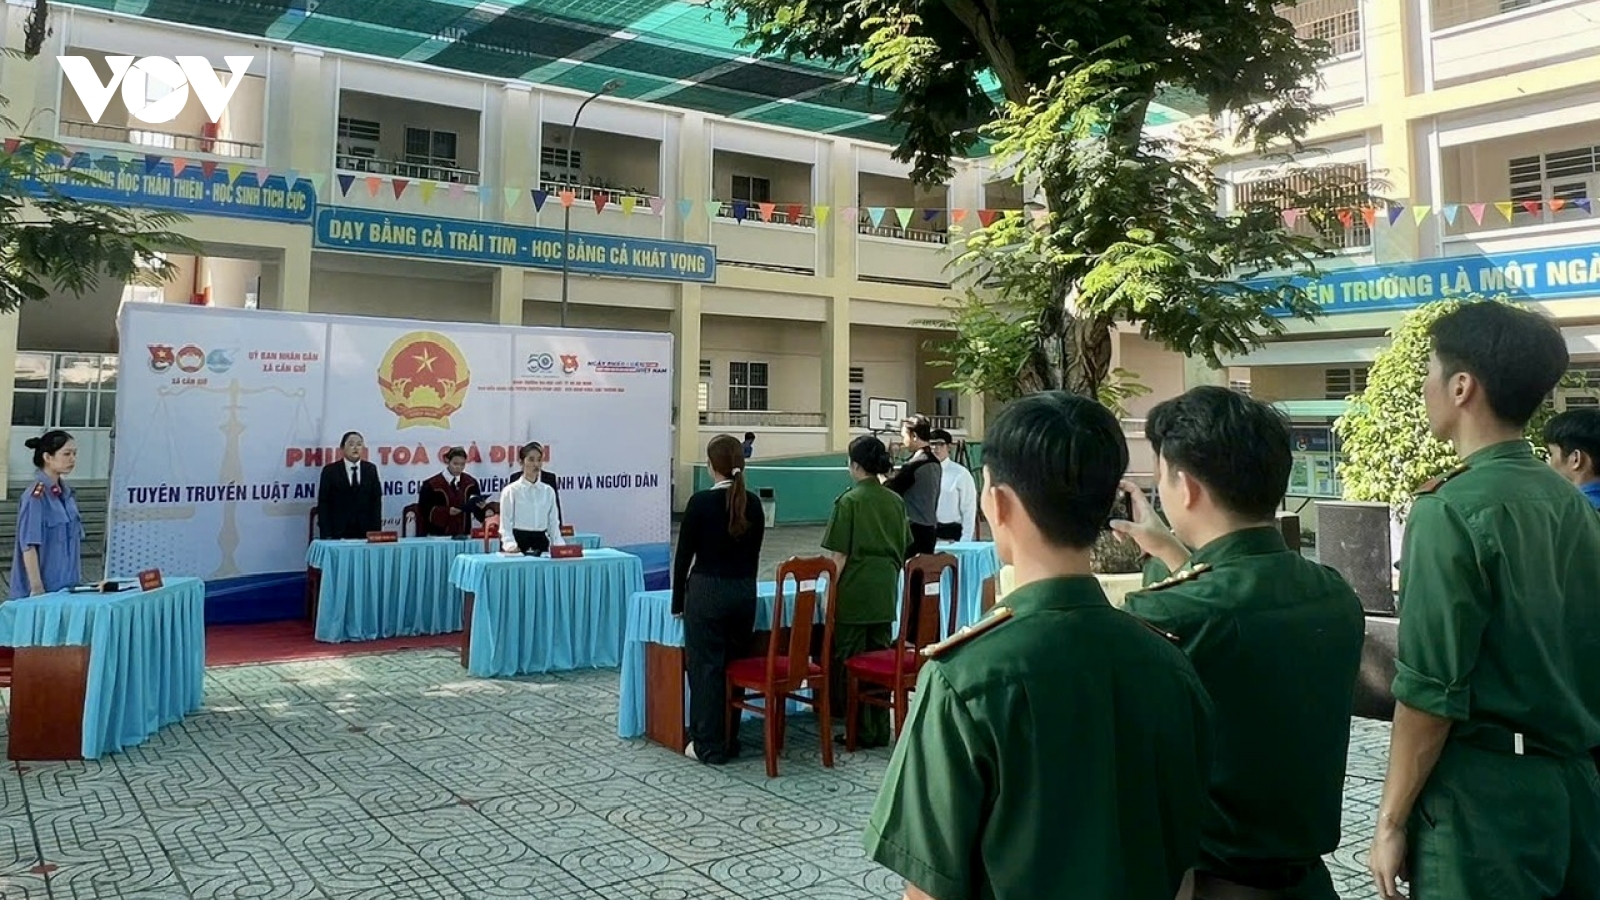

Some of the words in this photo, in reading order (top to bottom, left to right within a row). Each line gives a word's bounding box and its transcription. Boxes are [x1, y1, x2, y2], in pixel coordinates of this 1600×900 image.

[173, 176, 205, 203] THIỆN
[212, 182, 234, 206] HỌC
[235, 186, 261, 206] SINH
[262, 186, 285, 208] TÍCH
[329, 219, 365, 244] DẠY
[369, 217, 417, 246] BẰNG
[421, 223, 444, 249] CẢ
[448, 229, 484, 253] TRÁI
[488, 235, 517, 255] TIM
[531, 239, 562, 263] HỌC
[567, 238, 606, 264] BẰNG
[609, 242, 629, 266] CẢ
[632, 247, 667, 269] KHÁT
[670, 253, 706, 275] VỌNG
[1340, 273, 1434, 303] TRƯỜNG
[1440, 265, 1472, 297] LÀ
[1479, 260, 1538, 295] MỘT
[286, 447, 369, 468] PHI
[378, 442, 430, 466] TOÀ
[490, 445, 550, 468] ĐỊ
[127, 483, 181, 504] TUYÊN
[251, 481, 290, 503] LUẬT
[294, 482, 316, 499] AN
[578, 473, 593, 490] VÀ
[596, 472, 632, 489] NGƯỜI
[635, 471, 658, 488] DÂN
